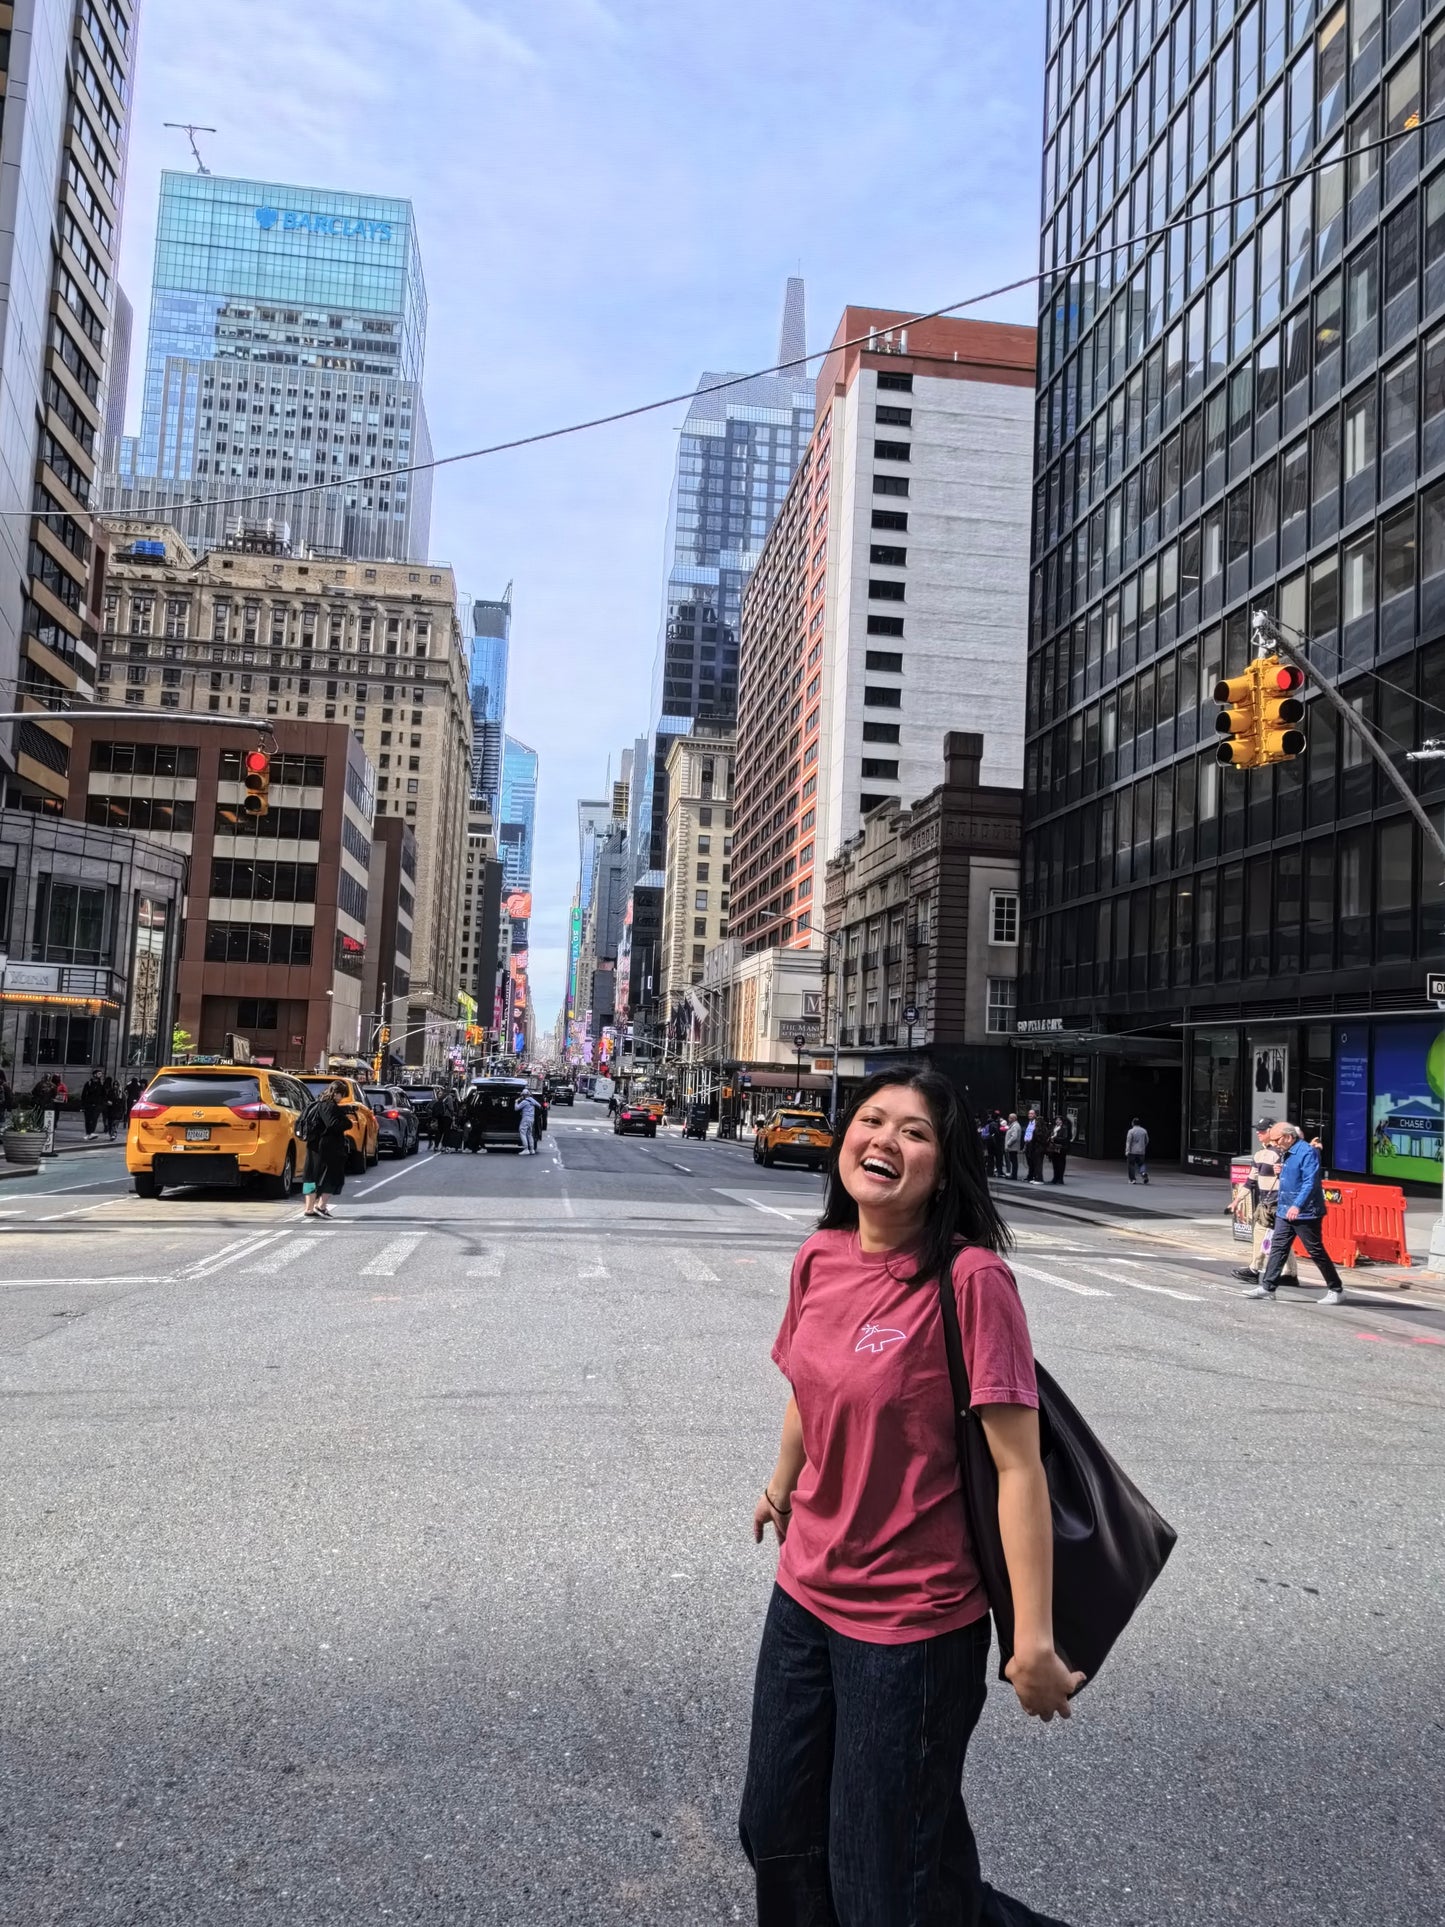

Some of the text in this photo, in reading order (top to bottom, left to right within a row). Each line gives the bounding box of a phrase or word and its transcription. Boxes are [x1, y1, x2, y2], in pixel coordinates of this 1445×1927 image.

[283, 211, 392, 241] BARCLAYS
[806, 995, 822, 1013] M
[781, 1023, 797, 1031] THE
[1400, 1118, 1425, 1129] CHASE
